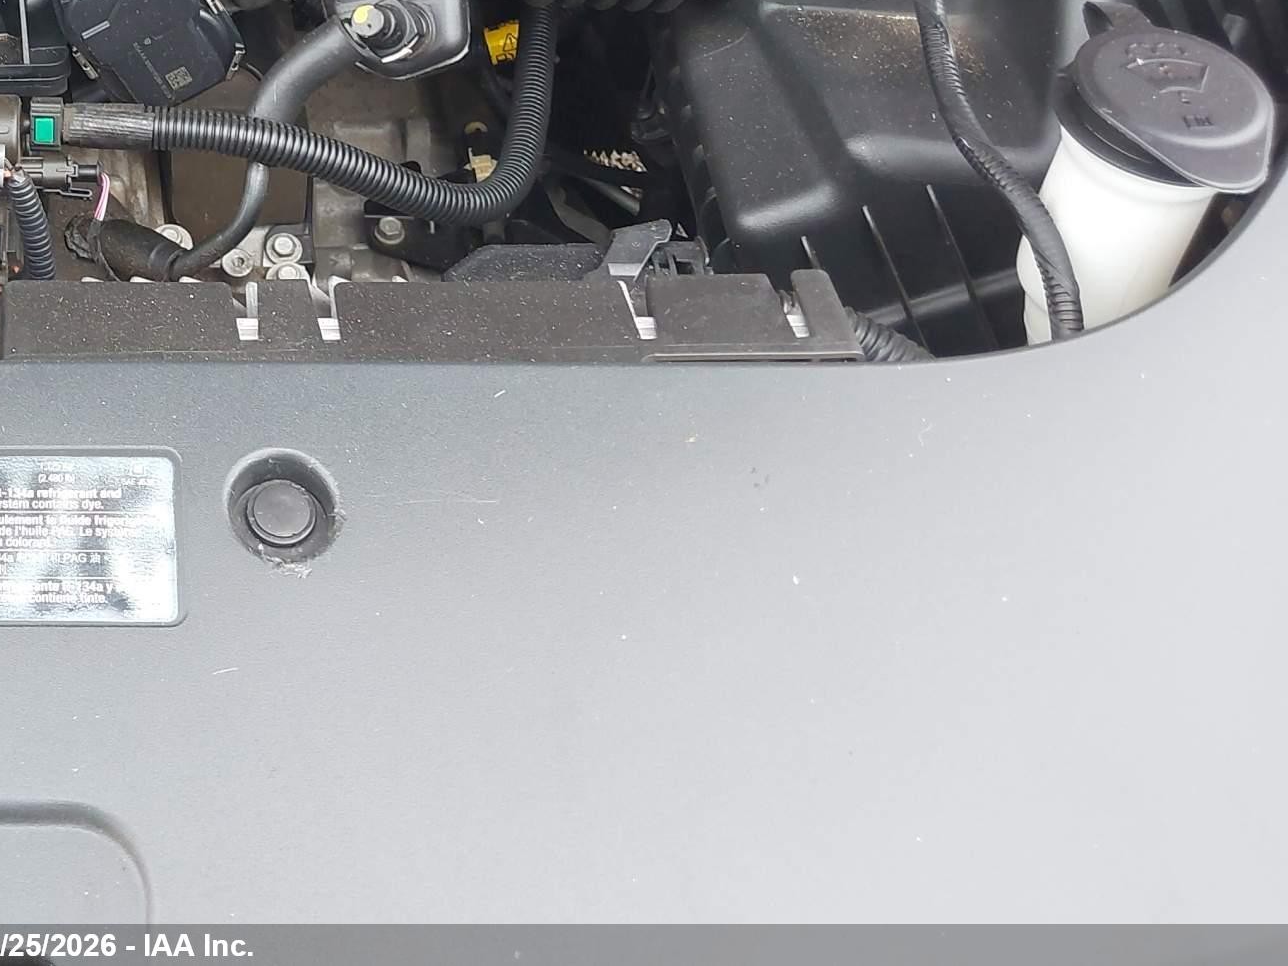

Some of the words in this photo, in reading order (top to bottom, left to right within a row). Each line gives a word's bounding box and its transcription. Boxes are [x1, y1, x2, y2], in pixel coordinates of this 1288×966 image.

[99, 488, 122, 499] and
[31, 498, 79, 510] contains
[81, 498, 104, 511] dye.
